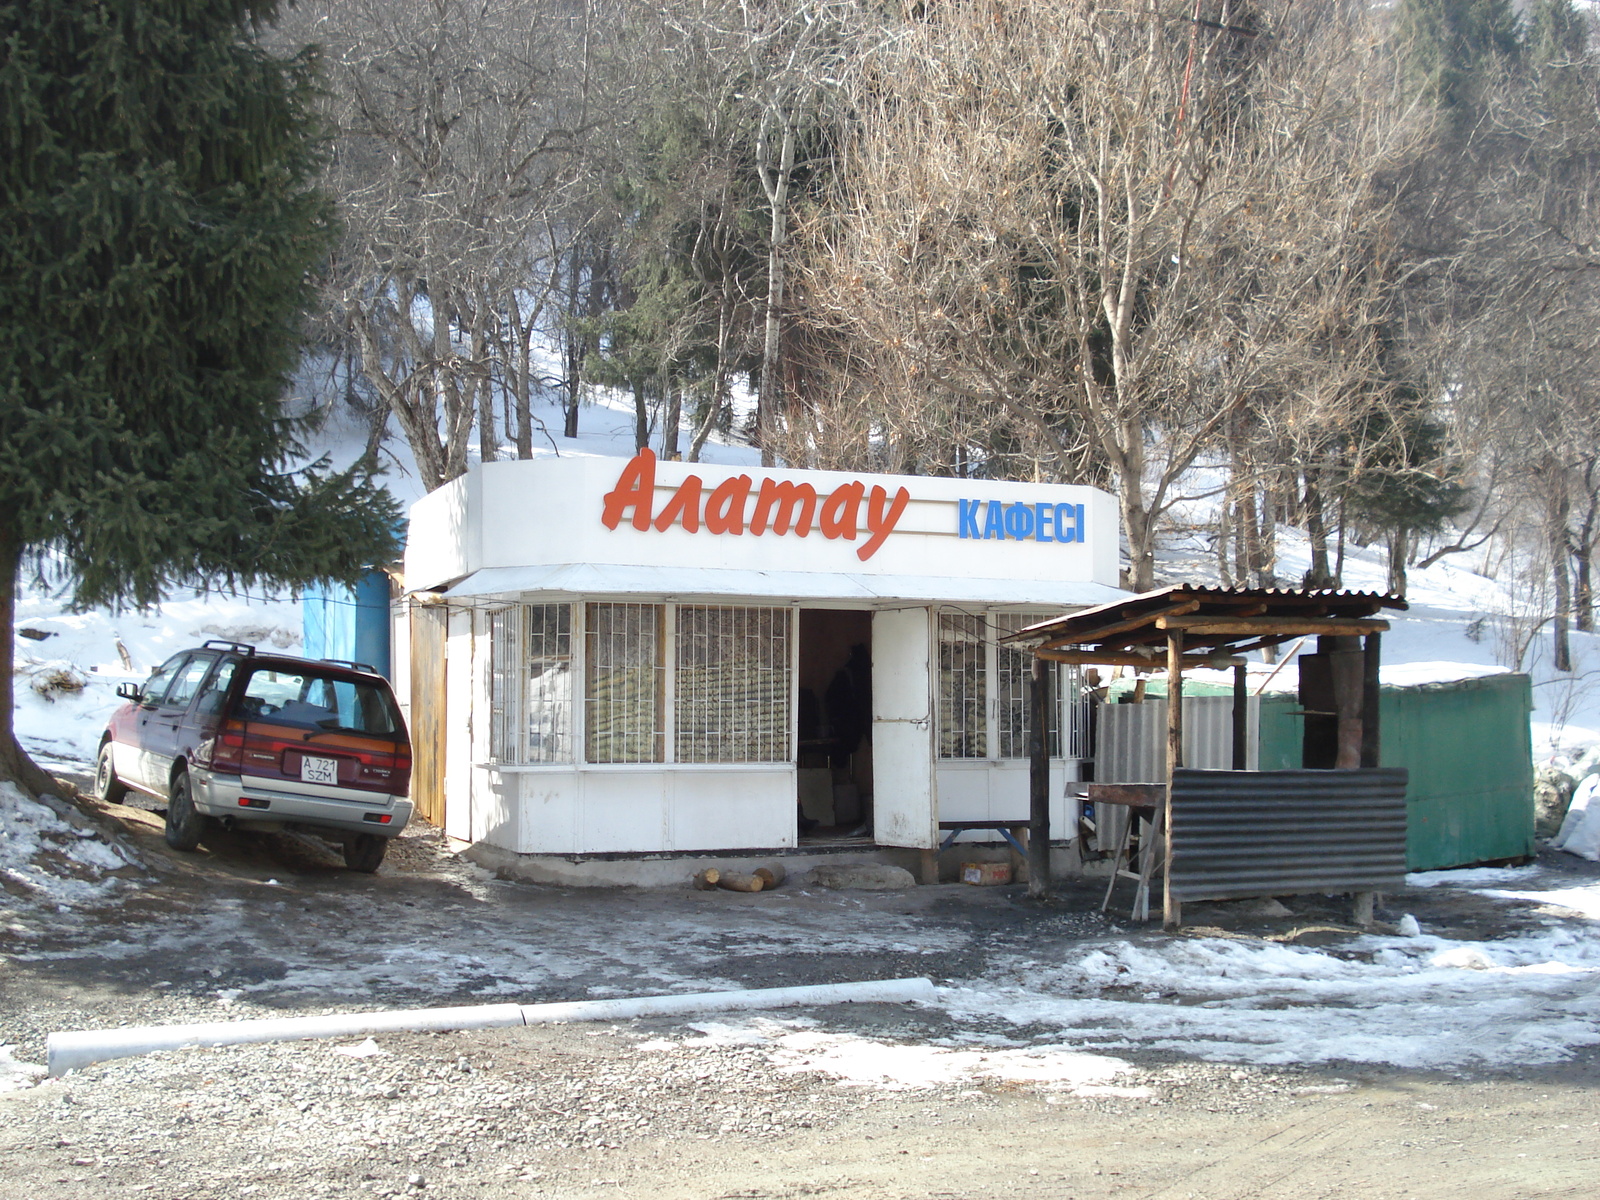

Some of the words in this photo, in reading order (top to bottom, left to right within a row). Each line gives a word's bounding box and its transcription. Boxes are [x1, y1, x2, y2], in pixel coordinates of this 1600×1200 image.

[601, 447, 910, 562] Алатау
[959, 498, 1085, 543] КАФЕСІ
[303, 757, 311, 769] A
[316, 759, 336, 772] 721
[307, 769, 332, 782] SZM
